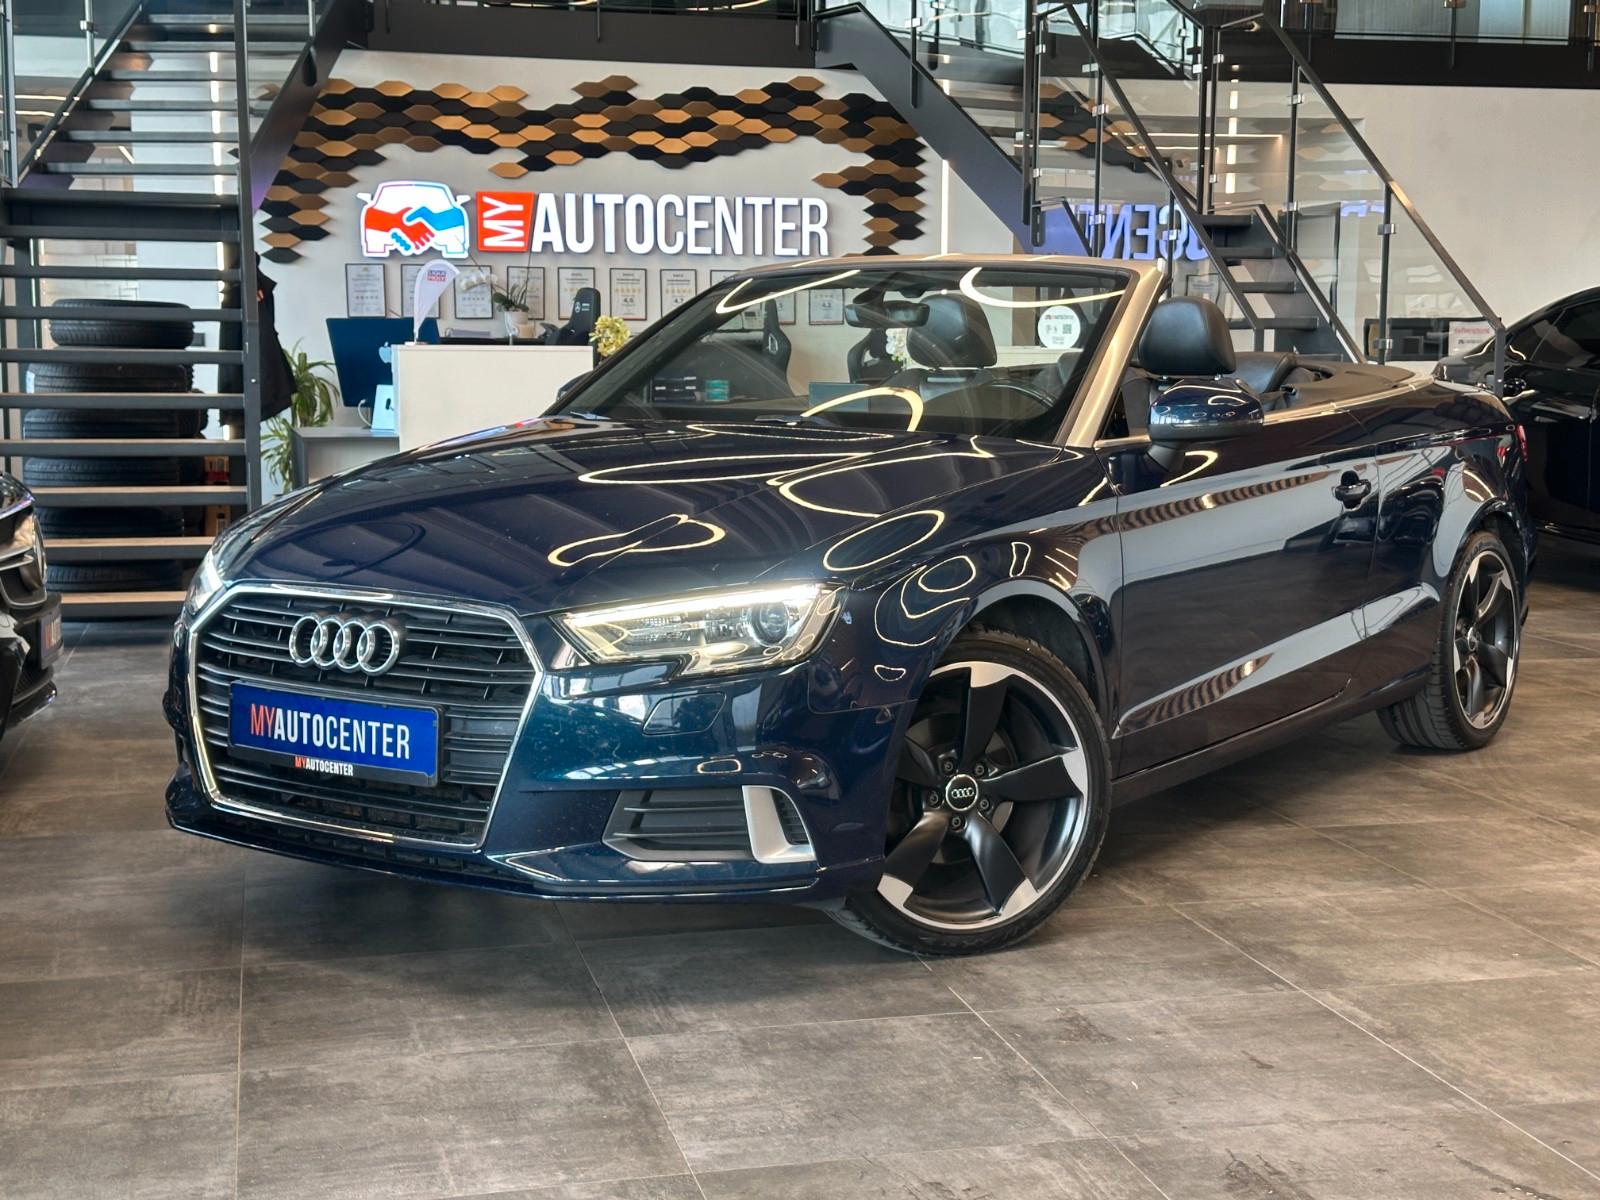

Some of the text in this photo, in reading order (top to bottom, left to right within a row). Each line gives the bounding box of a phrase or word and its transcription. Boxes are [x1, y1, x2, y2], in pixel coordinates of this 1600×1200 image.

[482, 192, 829, 256] MY AUTOCENTER
[250, 703, 410, 760] MYAUTOCENTER
[294, 756, 354, 776] MYAUTOCENTER
